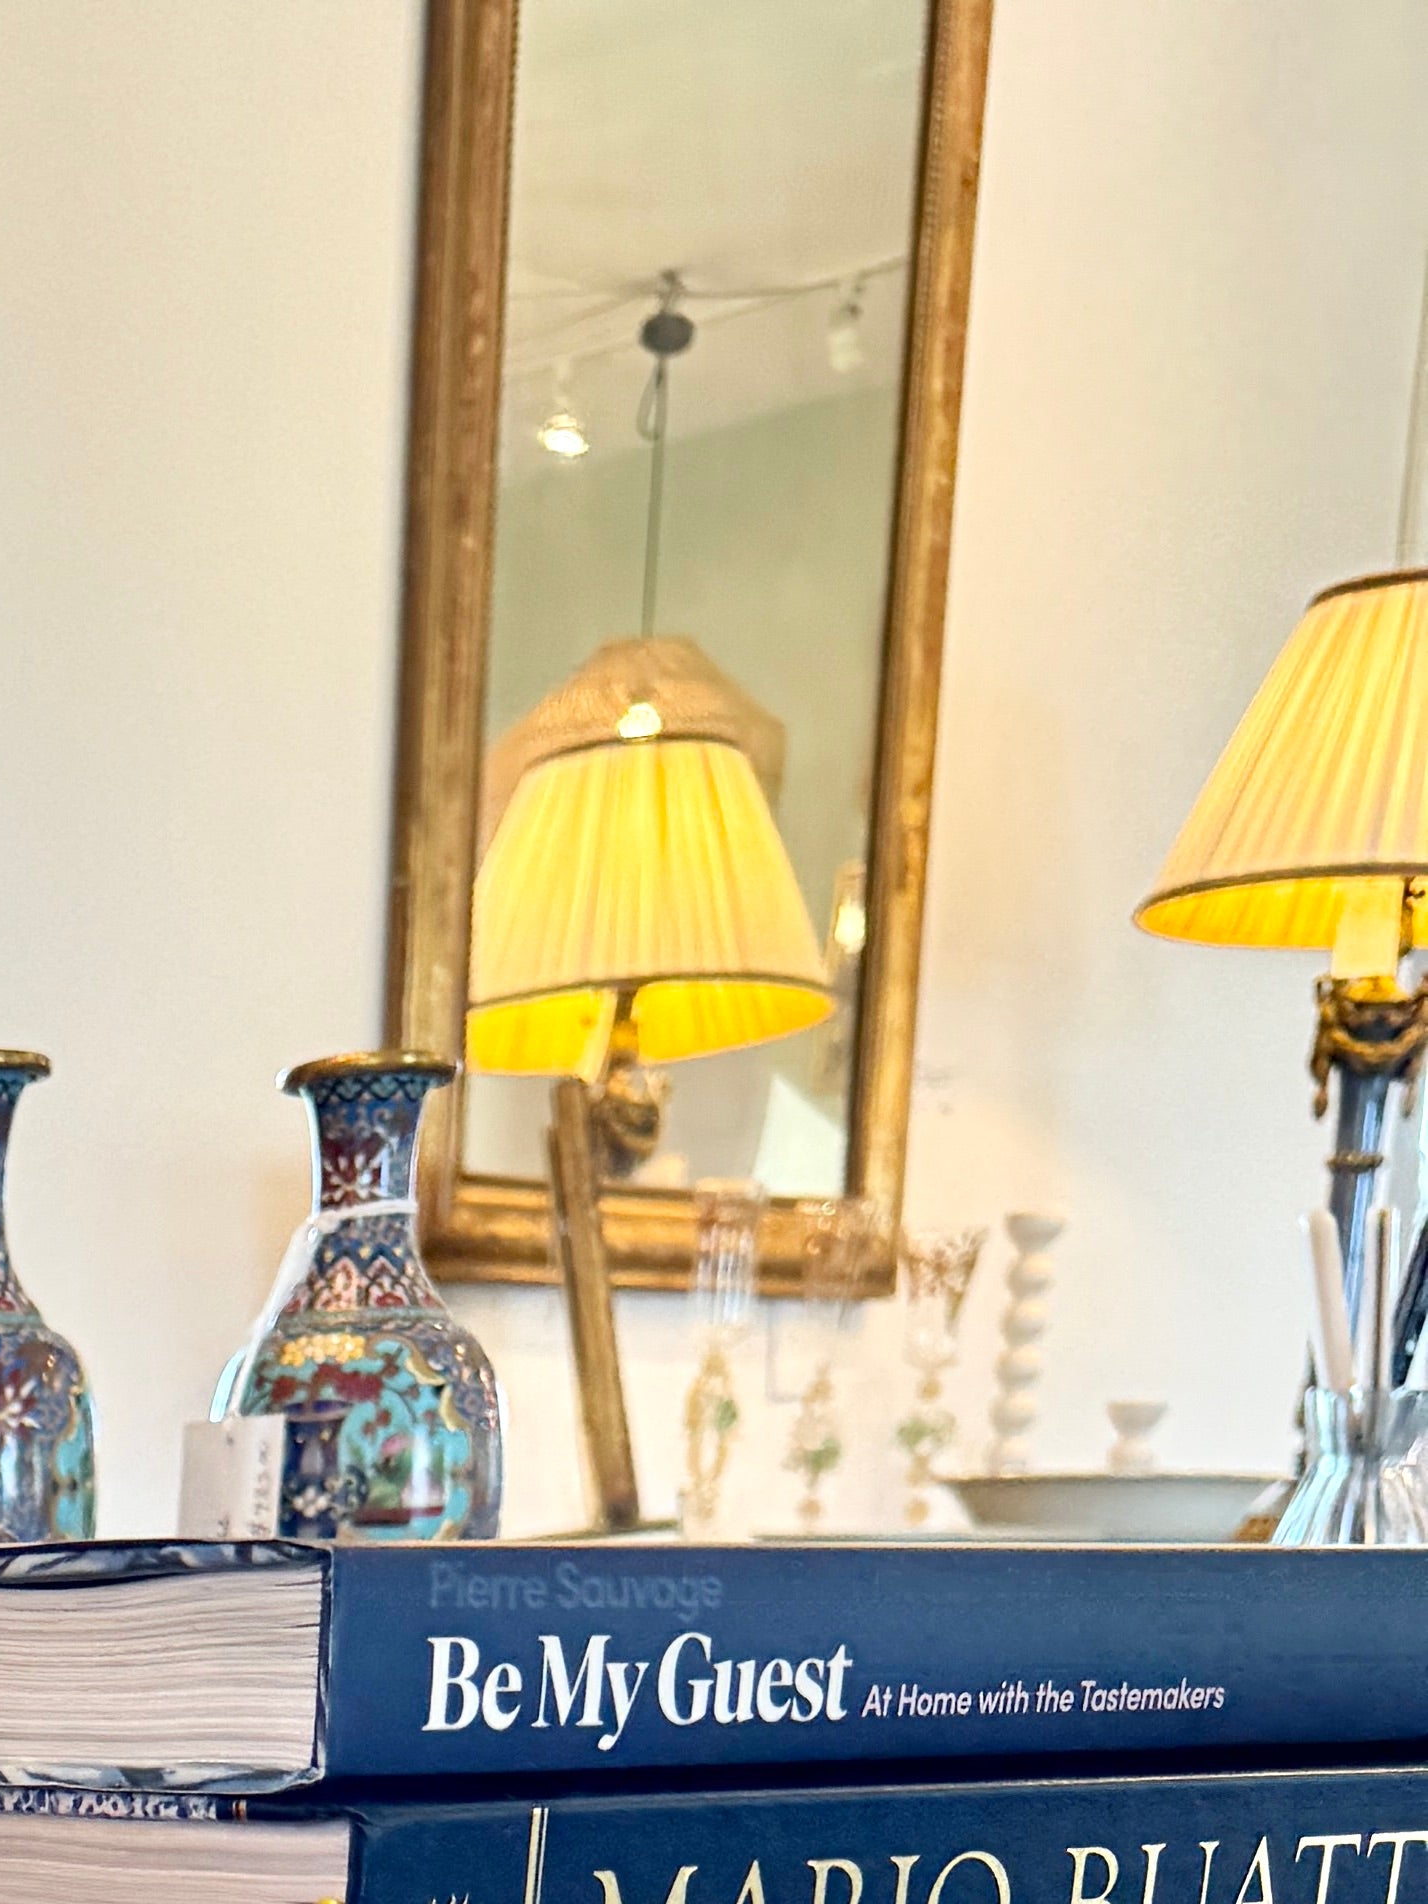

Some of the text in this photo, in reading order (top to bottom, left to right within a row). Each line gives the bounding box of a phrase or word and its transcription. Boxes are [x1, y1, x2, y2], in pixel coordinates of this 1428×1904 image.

[428, 1560, 723, 1623] Pierre Sauvage
[421, 1631, 853, 1751] Be My Guest
[861, 1676, 1226, 1718] At Home with the Tastemakers
